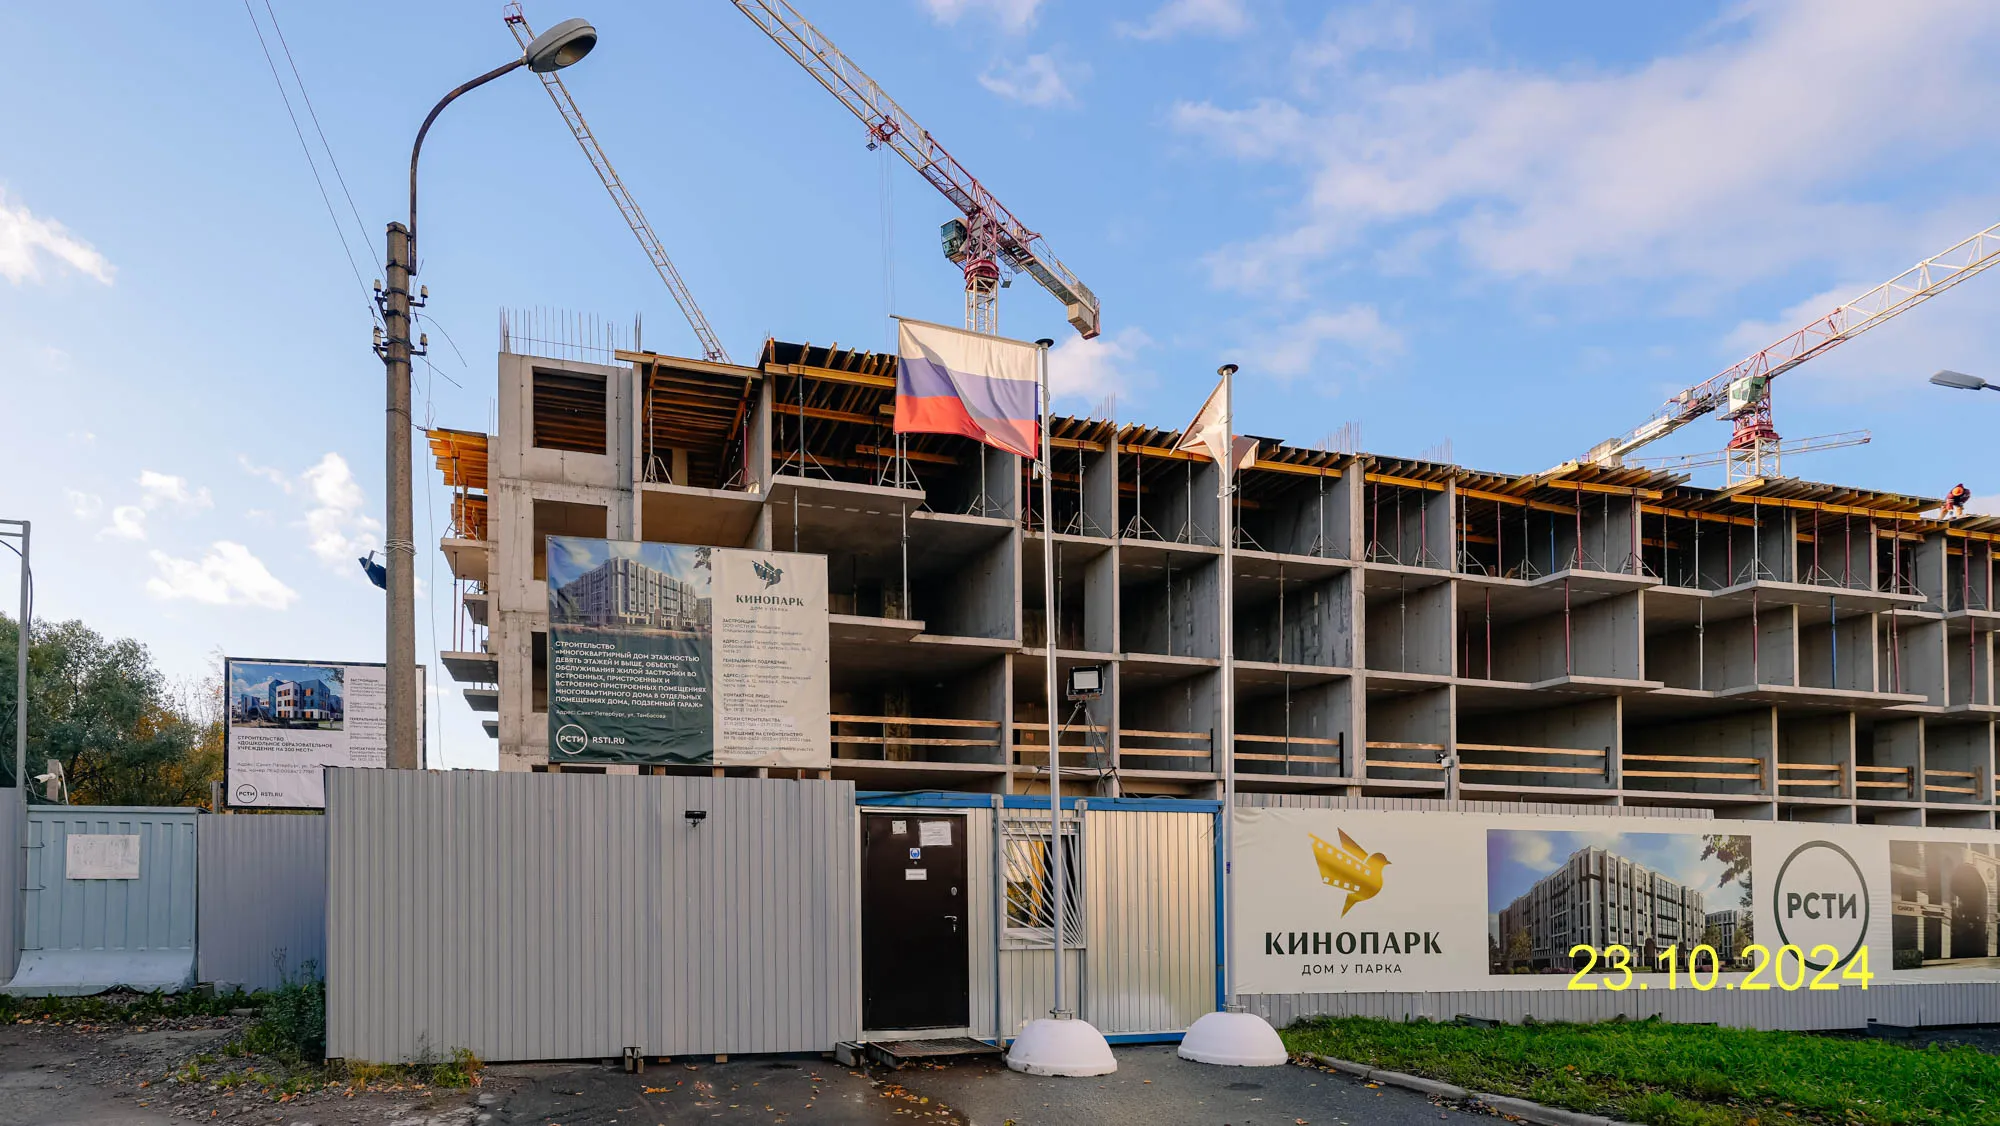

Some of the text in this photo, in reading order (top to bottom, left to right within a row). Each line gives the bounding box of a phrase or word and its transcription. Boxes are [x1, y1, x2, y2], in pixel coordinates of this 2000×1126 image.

[736, 594, 804, 606] КИНОПАРК
[555, 641, 615, 650] СТРОИТЕЛЬСТВО
[555, 649, 632, 659] «МНОГОКВАРТИРНЫЙ
[651, 654, 700, 662] ЭТАЖНОСТЬЮ
[583, 658, 613, 666] ЭТАЖЕЙ
[621, 660, 644, 668] ВЫШЕ,
[646, 661, 679, 669] ОБЪЕКТЫ
[555, 665, 615, 673] ОБСЛУЖИВАНИЯ
[616, 667, 643, 675] ЖИЛОЙ
[645, 669, 686, 677] ЗАСТРОЙКИ
[555, 672, 605, 681] ВСТРОЕННЫХ,
[607, 675, 663, 683] ПРИСТРОЕННЫХ
[555, 681, 707, 693] ВСТРОЕННО-ПРИСТРОЕННЫХ ПОМЕЩЕНИЯХ
[555, 689, 631, 697] МНОГОКВАРТИРНОГО
[555, 696, 606, 704] ПОМЕЩЕНИЯХ
[607, 698, 630, 706] ДОМА,
[560, 735, 584, 743] РСТИ
[592, 736, 625, 745] RSTI.RU
[1787, 892, 1857, 920] РСТИ
[1265, 931, 1443, 955] КИНОПАРК
[1301, 963, 1402, 976] ДОМ У ПАРКА
